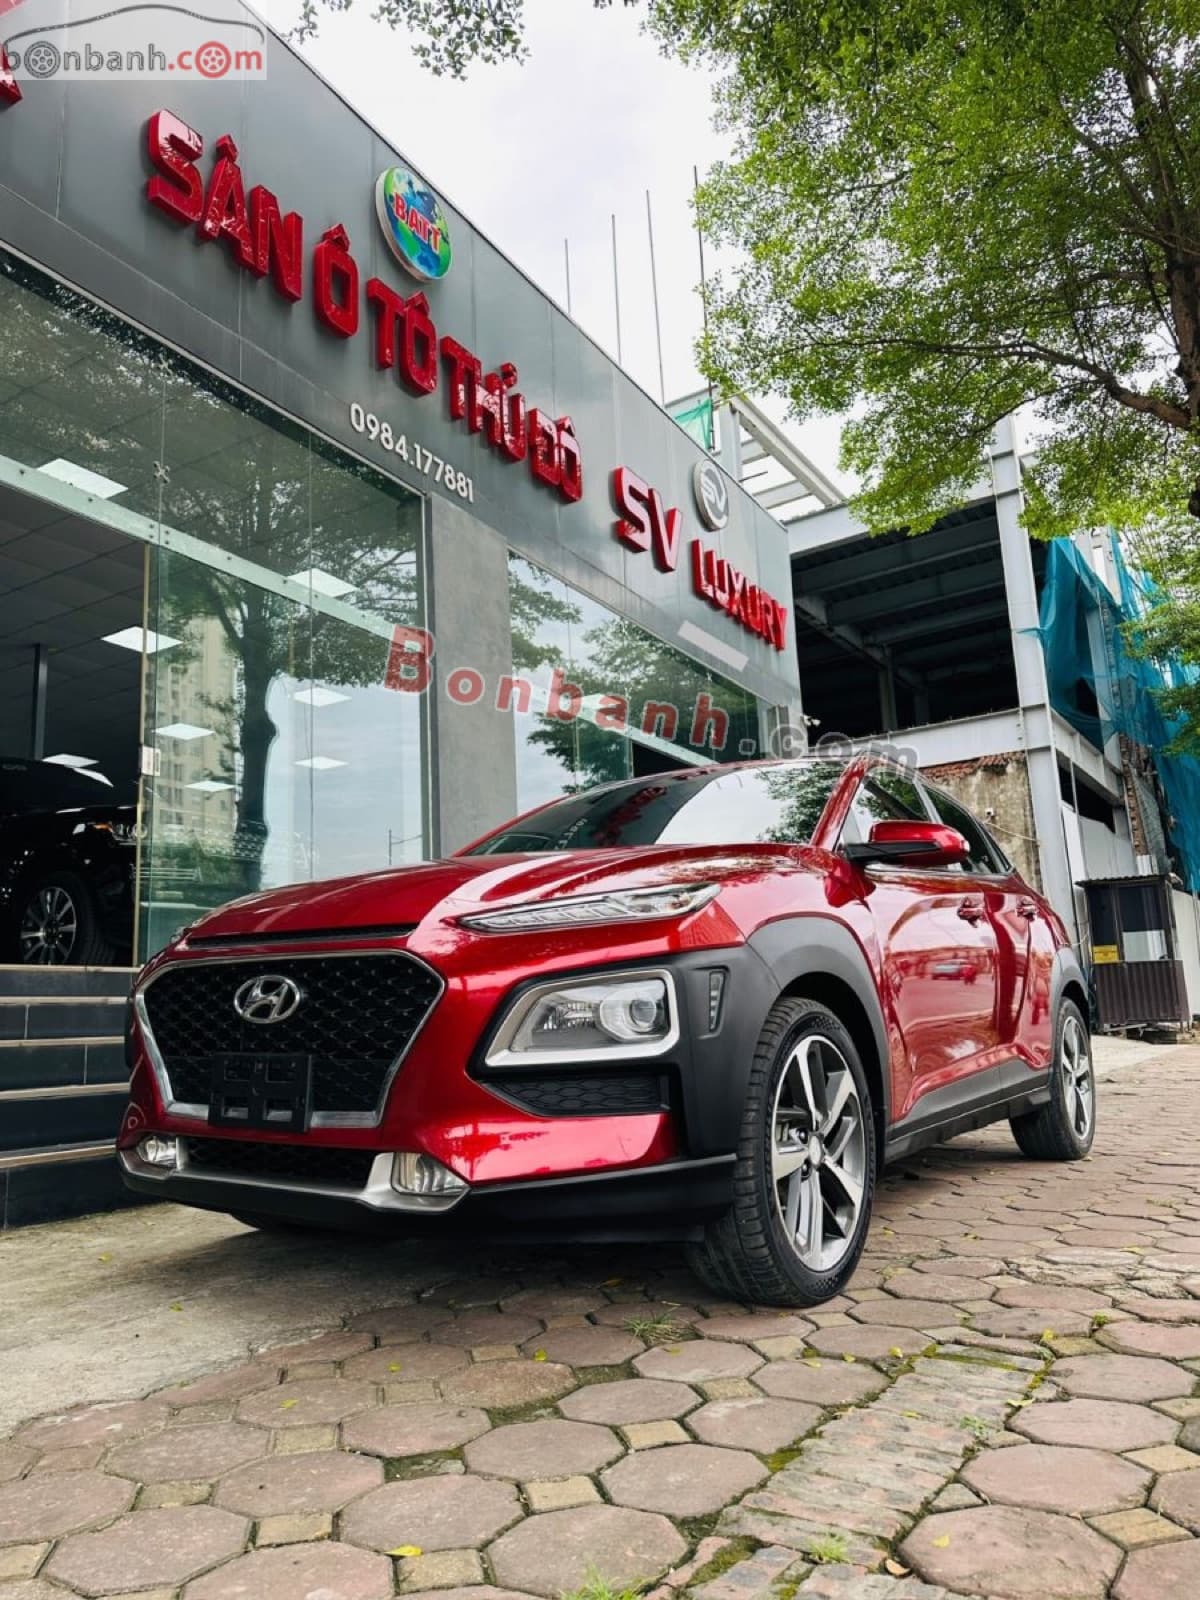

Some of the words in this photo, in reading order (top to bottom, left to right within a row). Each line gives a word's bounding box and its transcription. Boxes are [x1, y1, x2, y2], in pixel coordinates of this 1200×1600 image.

[393, 191, 442, 255] BATT
[313, 223, 359, 338] Ô
[366, 277, 437, 397] TÔ
[440, 335, 526, 462] THỦ
[527, 407, 583, 502] ĐÔ
[350, 402, 474, 503] 0984.177881
[613, 465, 683, 574] SV
[690, 539, 788, 653] LUXURY
